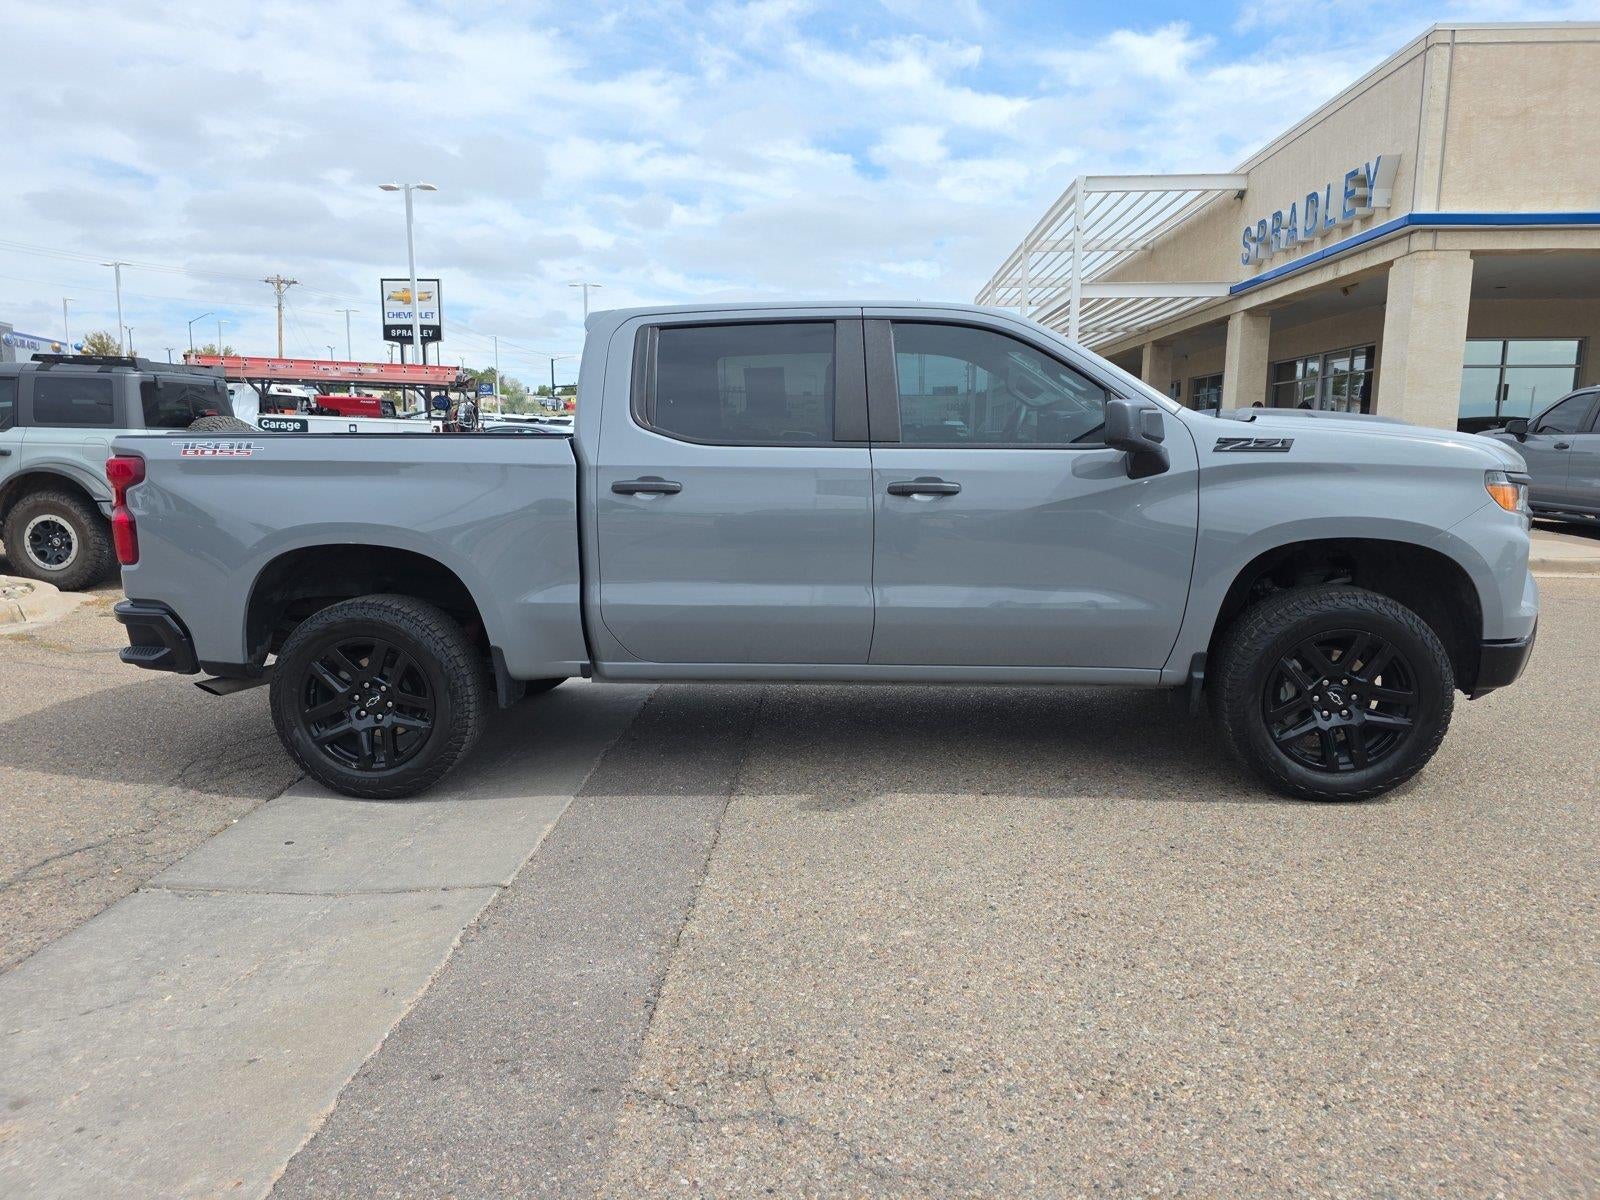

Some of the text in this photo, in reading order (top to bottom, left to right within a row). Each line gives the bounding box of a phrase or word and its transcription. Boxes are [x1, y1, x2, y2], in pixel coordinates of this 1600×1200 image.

[1241, 154, 1382, 266] SPRADLEY
[387, 311, 435, 319] CHEVRLET
[261, 419, 301, 433] Garage
[172, 441, 265, 451] TRAIL
[1213, 437, 1296, 453] Z71
[180, 449, 252, 457] BOSS
